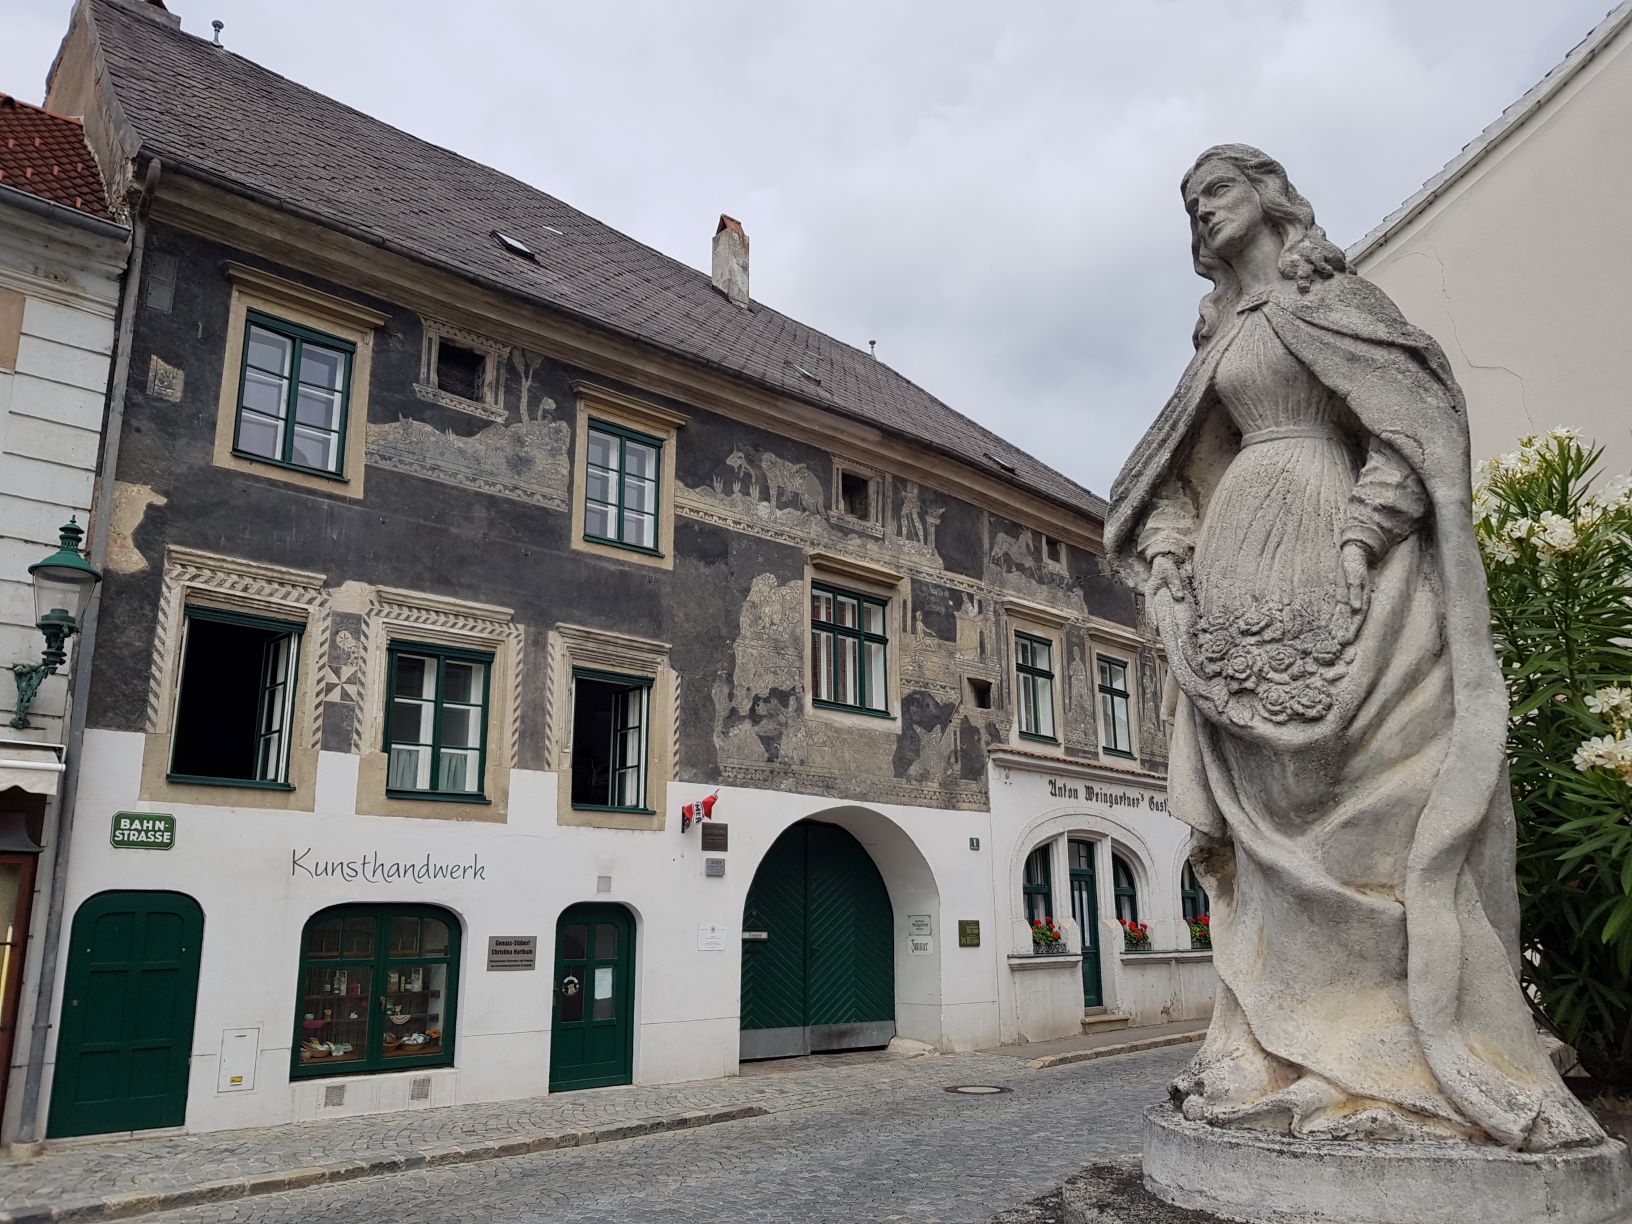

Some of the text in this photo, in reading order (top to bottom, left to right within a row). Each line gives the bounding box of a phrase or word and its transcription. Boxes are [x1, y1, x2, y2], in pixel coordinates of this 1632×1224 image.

[1048, 778, 1079, 800] Anton
[1084, 784, 1144, 808] Weingartner's
[120, 818, 169, 831] BAHN-
[114, 829, 171, 843] STRASSE
[292, 847, 486, 884] Kunsthandwerk
